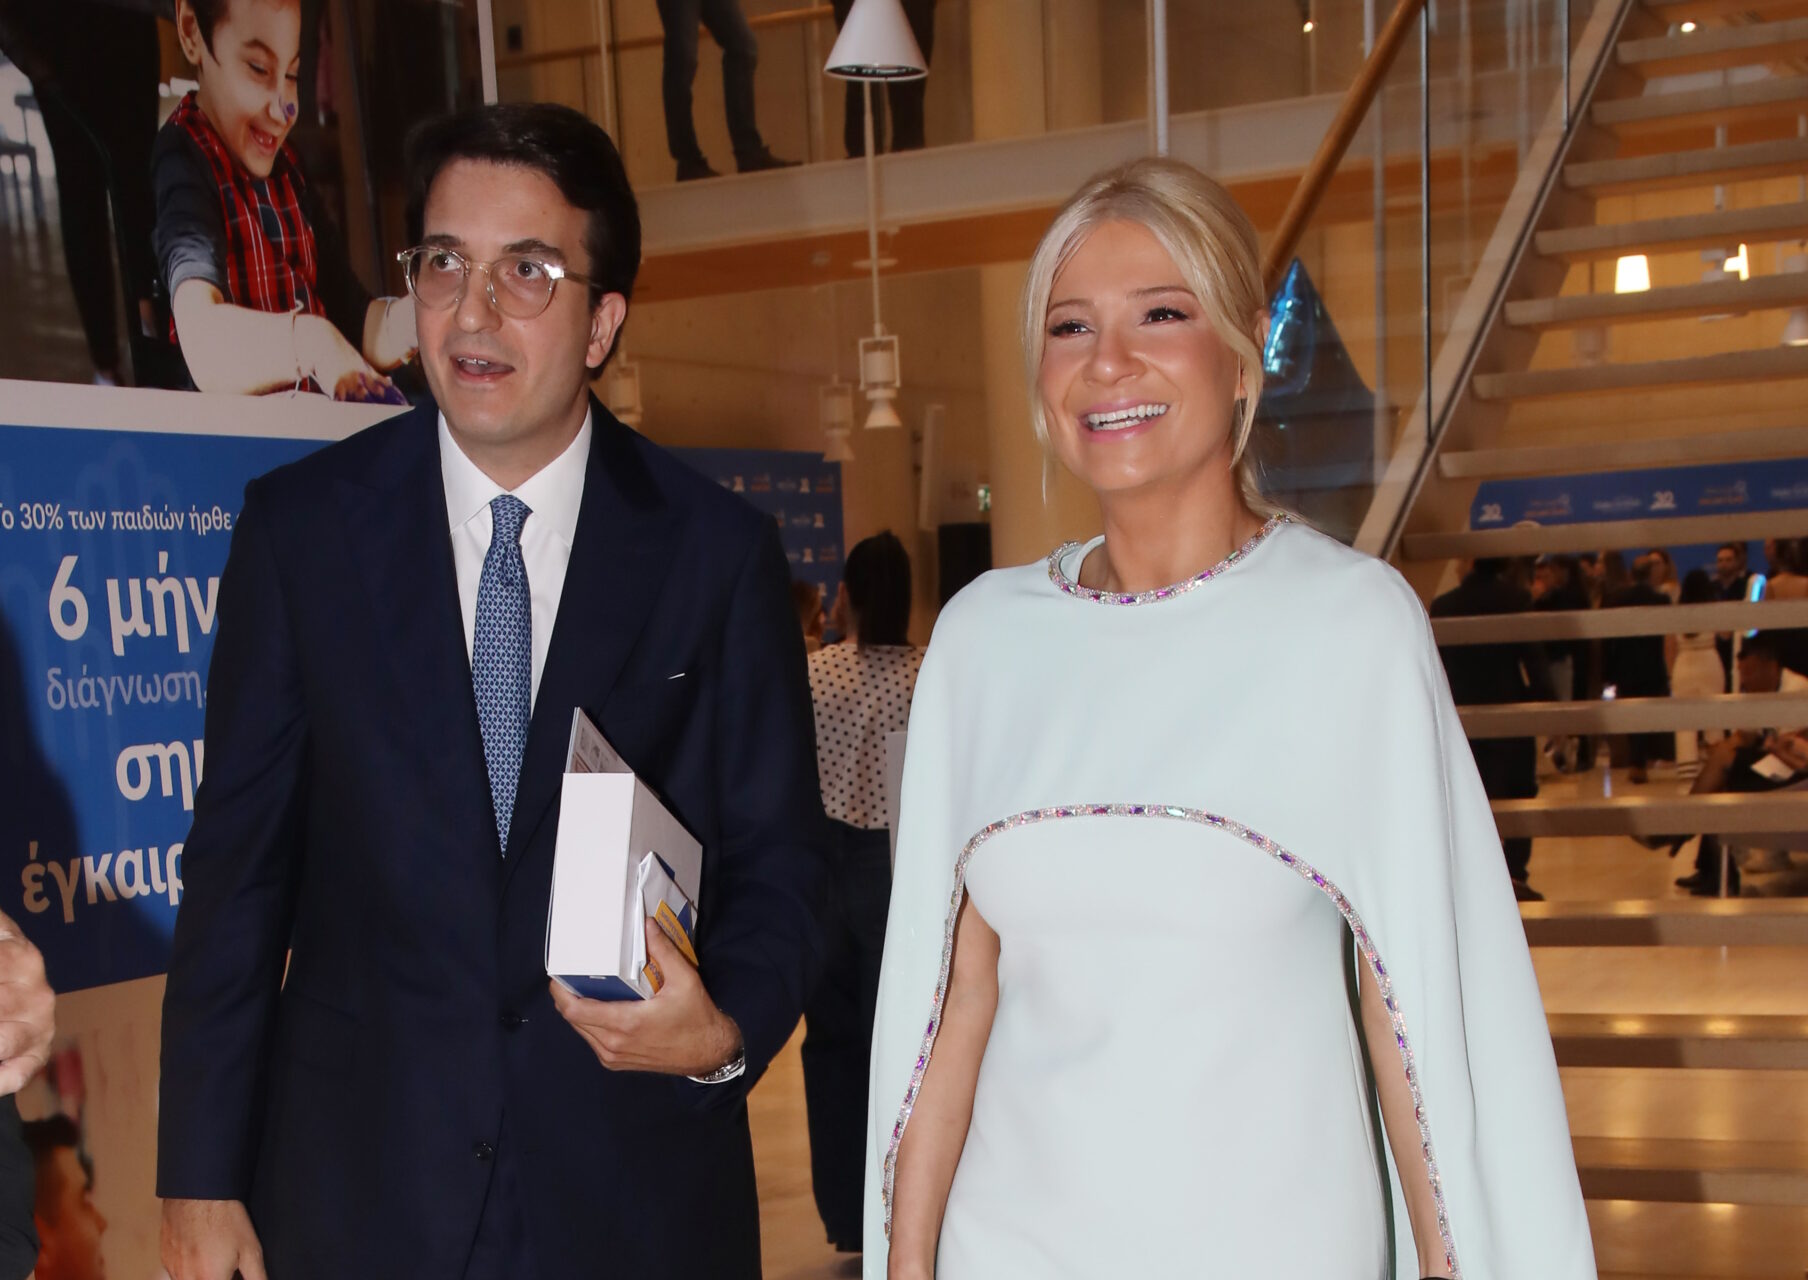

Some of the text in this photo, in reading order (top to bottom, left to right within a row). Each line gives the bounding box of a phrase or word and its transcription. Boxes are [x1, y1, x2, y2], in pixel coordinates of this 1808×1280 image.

[0, 503, 232, 536] ο 30% των παιδιών ήρθε
[49, 551, 220, 656] 6 μήν
